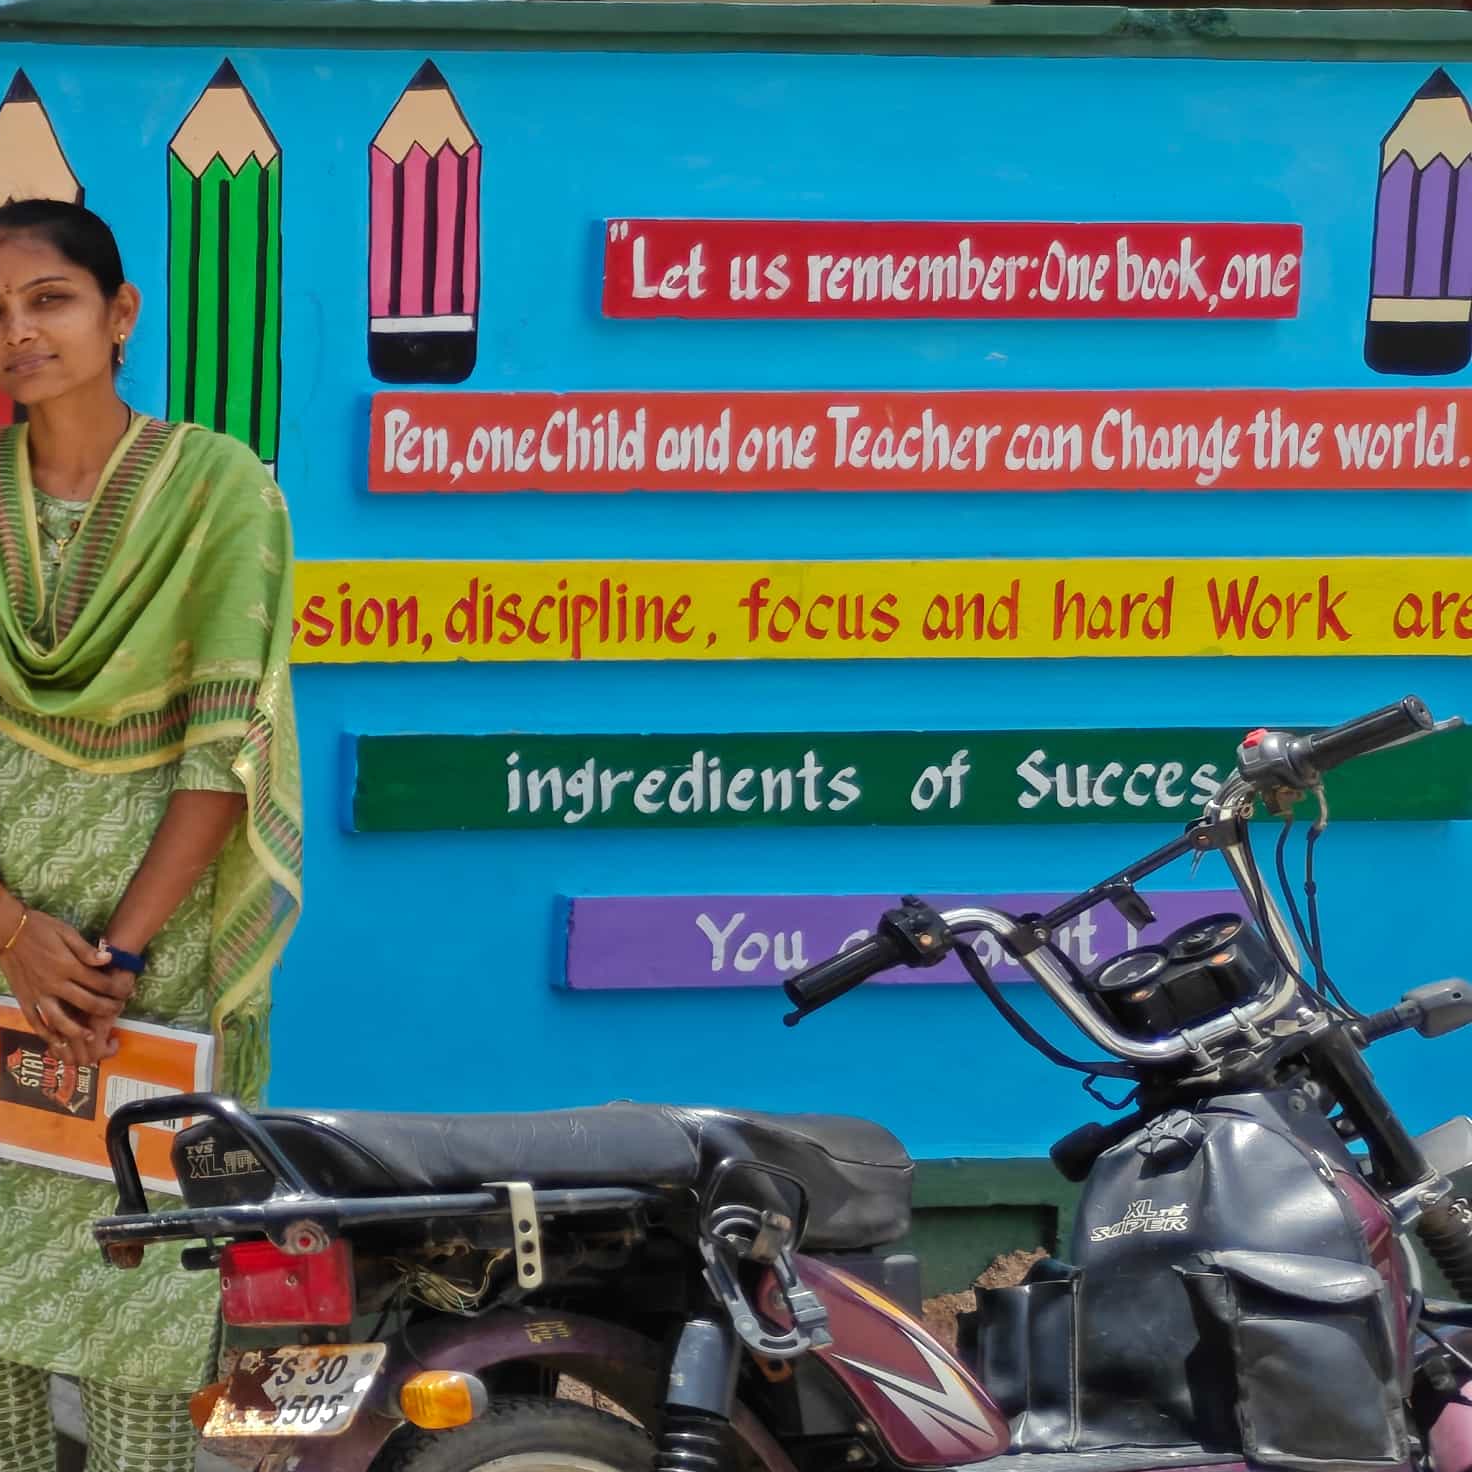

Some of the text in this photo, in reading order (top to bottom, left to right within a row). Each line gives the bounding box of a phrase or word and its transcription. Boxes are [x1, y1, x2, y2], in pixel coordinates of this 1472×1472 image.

[730, 252, 791, 300] us
[540, 408, 645, 472] Child
[656, 408, 730, 473] and
[737, 425, 816, 471] one
[827, 406, 1002, 471] Teacher
[1005, 423, 1083, 471] can
[1092, 408, 1240, 485] Change
[1247, 408, 1323, 470] the
[1334, 402, 1470, 470] world.
[292, 583, 432, 654] sion,
[738, 578, 899, 644] focus
[922, 578, 1020, 641] and
[1053, 576, 1174, 641] hard
[1207, 575, 1353, 641] Work
[505, 749, 1222, 823] ingredients of Succes
[696, 912, 808, 971] You
[1091, 1216, 1189, 1241] SUPER
[1124, 1199, 1157, 1219] XL
[307, 1355, 348, 1385] 30
